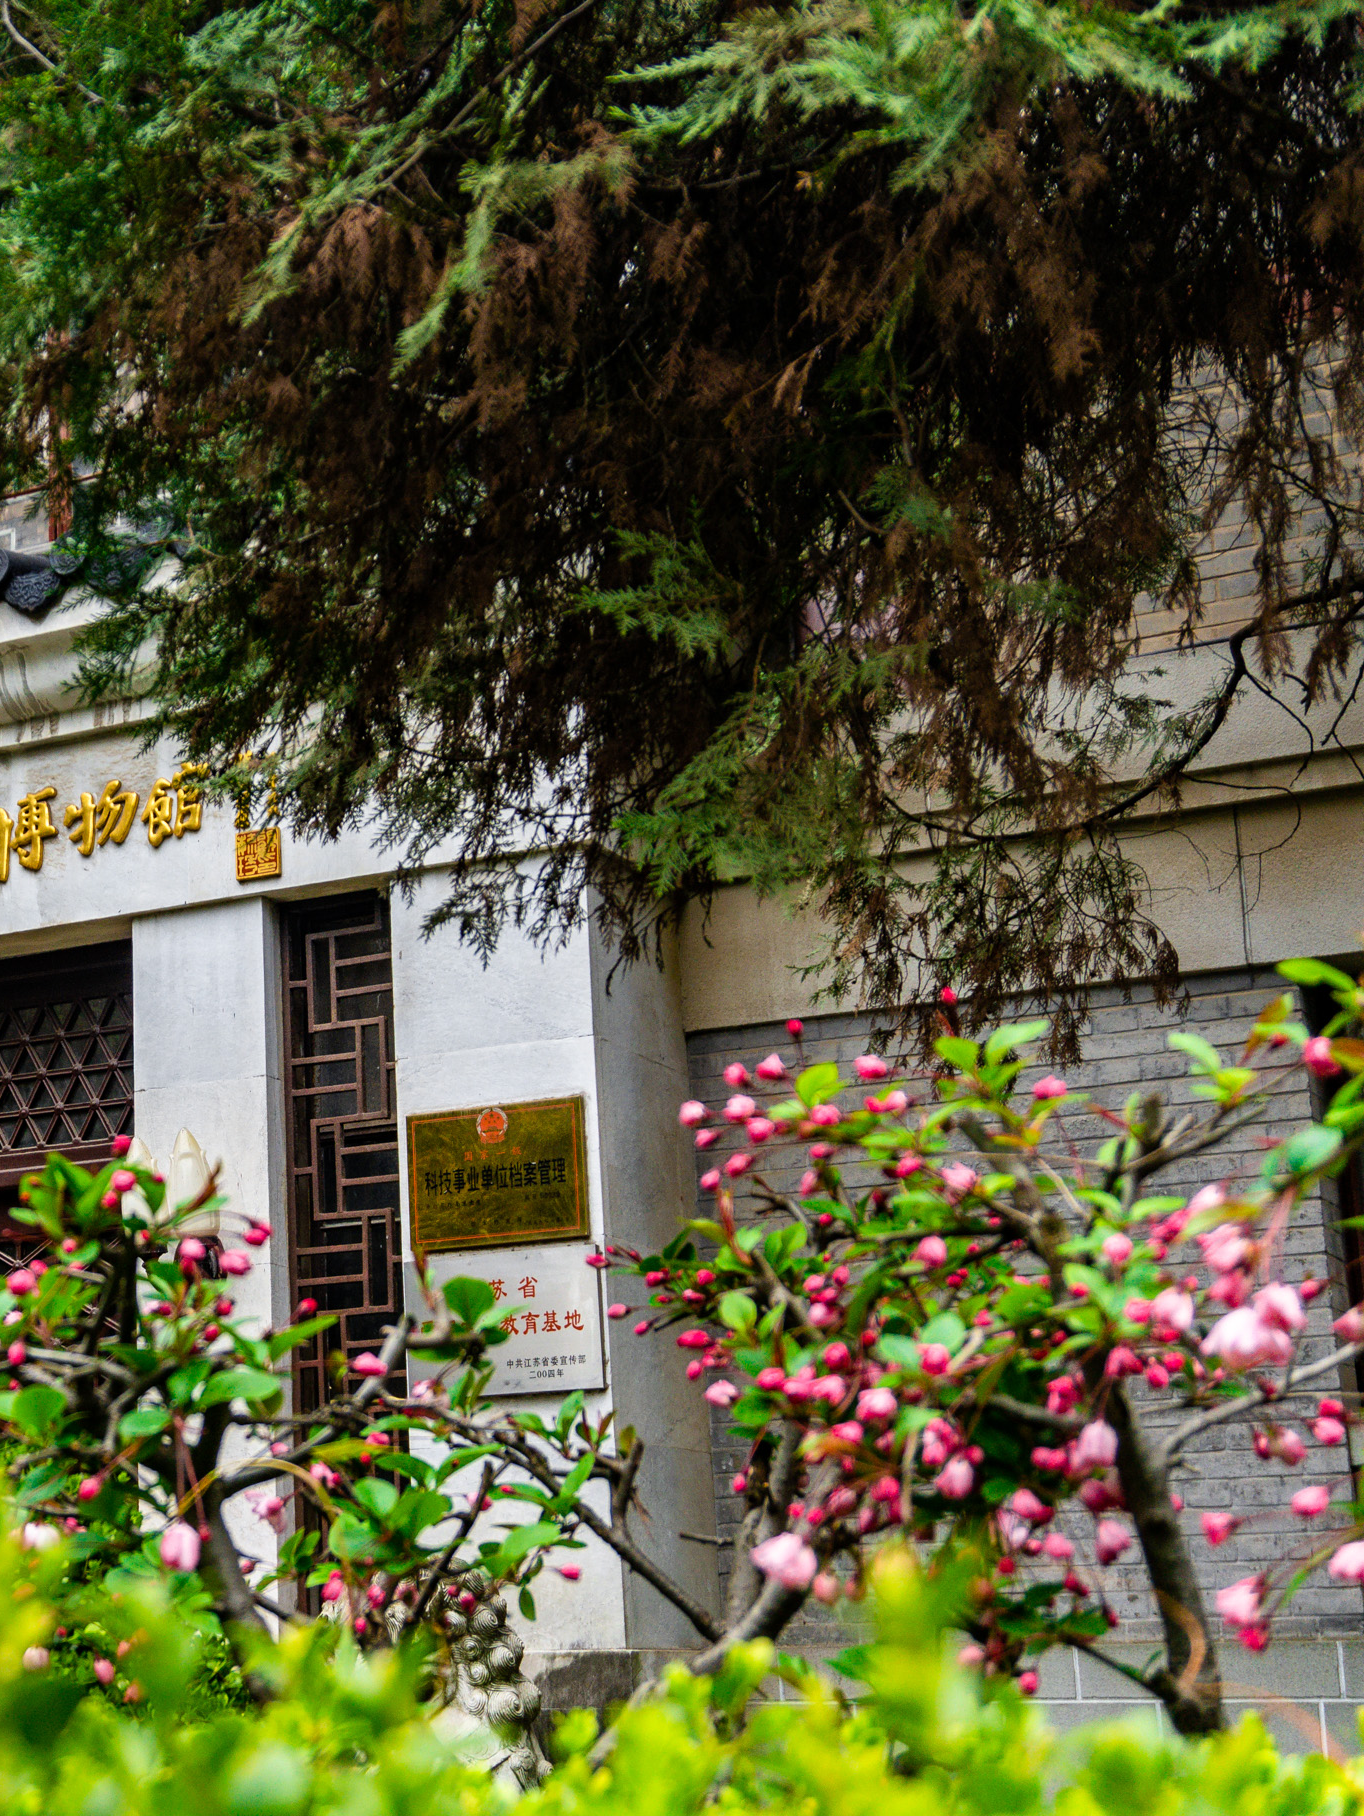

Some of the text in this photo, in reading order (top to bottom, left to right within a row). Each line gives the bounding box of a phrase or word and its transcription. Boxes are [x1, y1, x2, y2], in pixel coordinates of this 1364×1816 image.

[424, 1157, 566, 1197] 科技事业单位档案管理
[489, 1276, 538, 1301] 苏省
[506, 1354, 586, 1370] 中共江苏省委宣传部
